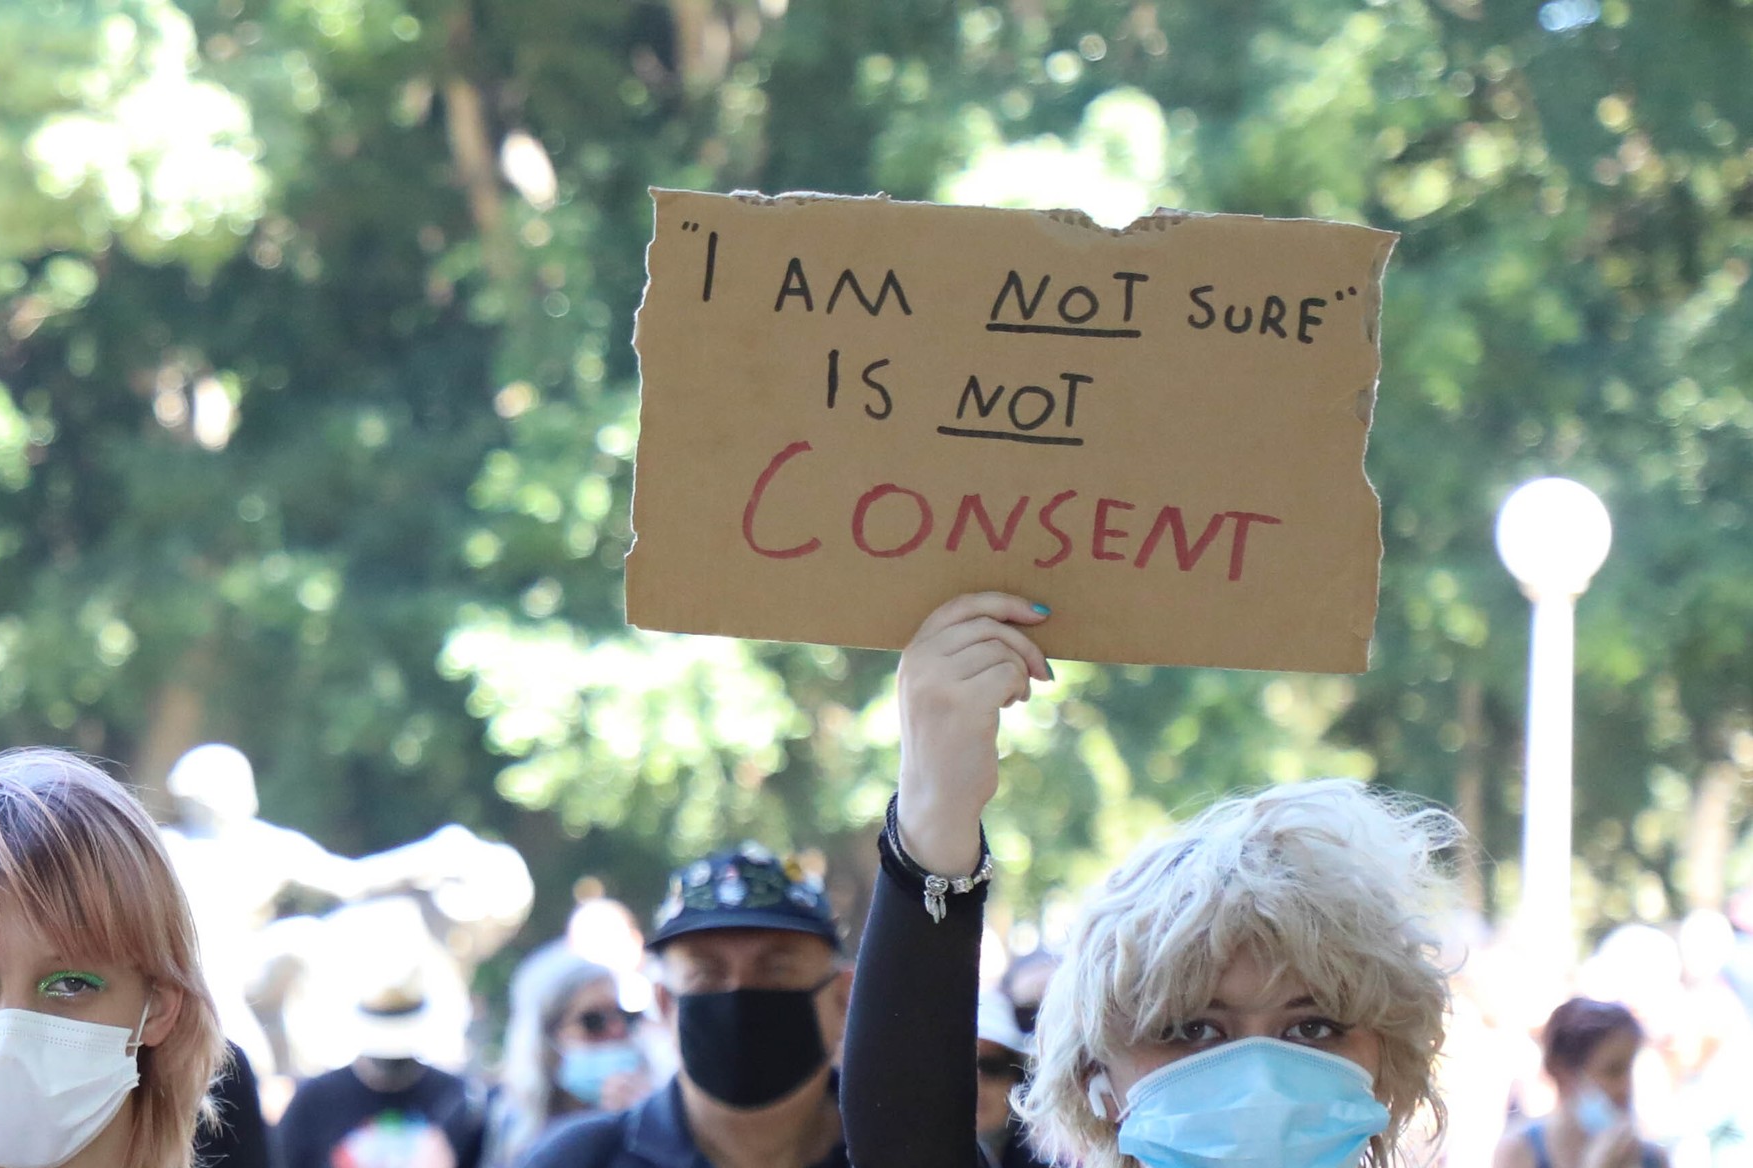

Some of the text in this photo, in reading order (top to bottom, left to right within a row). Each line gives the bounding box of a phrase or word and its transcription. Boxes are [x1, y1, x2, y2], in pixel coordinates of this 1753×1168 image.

[773, 256, 913, 317] AM
[987, 269, 1151, 339] NOT
[1186, 284, 1357, 346] SURE"
[825, 349, 1095, 447] IS NOT
[741, 440, 1282, 582] CONSENT
